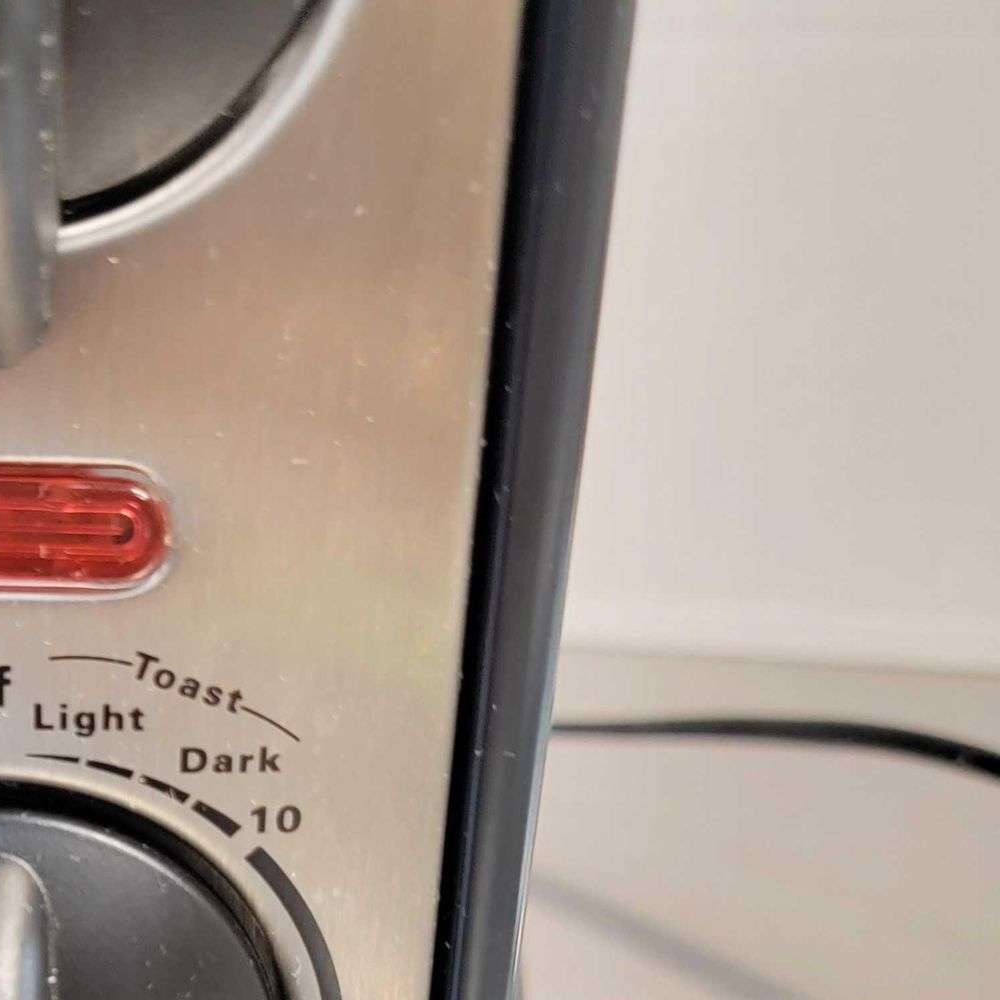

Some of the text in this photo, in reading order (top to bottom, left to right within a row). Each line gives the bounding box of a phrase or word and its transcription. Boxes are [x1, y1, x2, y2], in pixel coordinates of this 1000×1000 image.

[136, 651, 244, 714] Toast
[34, 703, 144, 737] Light
[180, 746, 281, 774] Dark
[251, 805, 302, 834] 10
